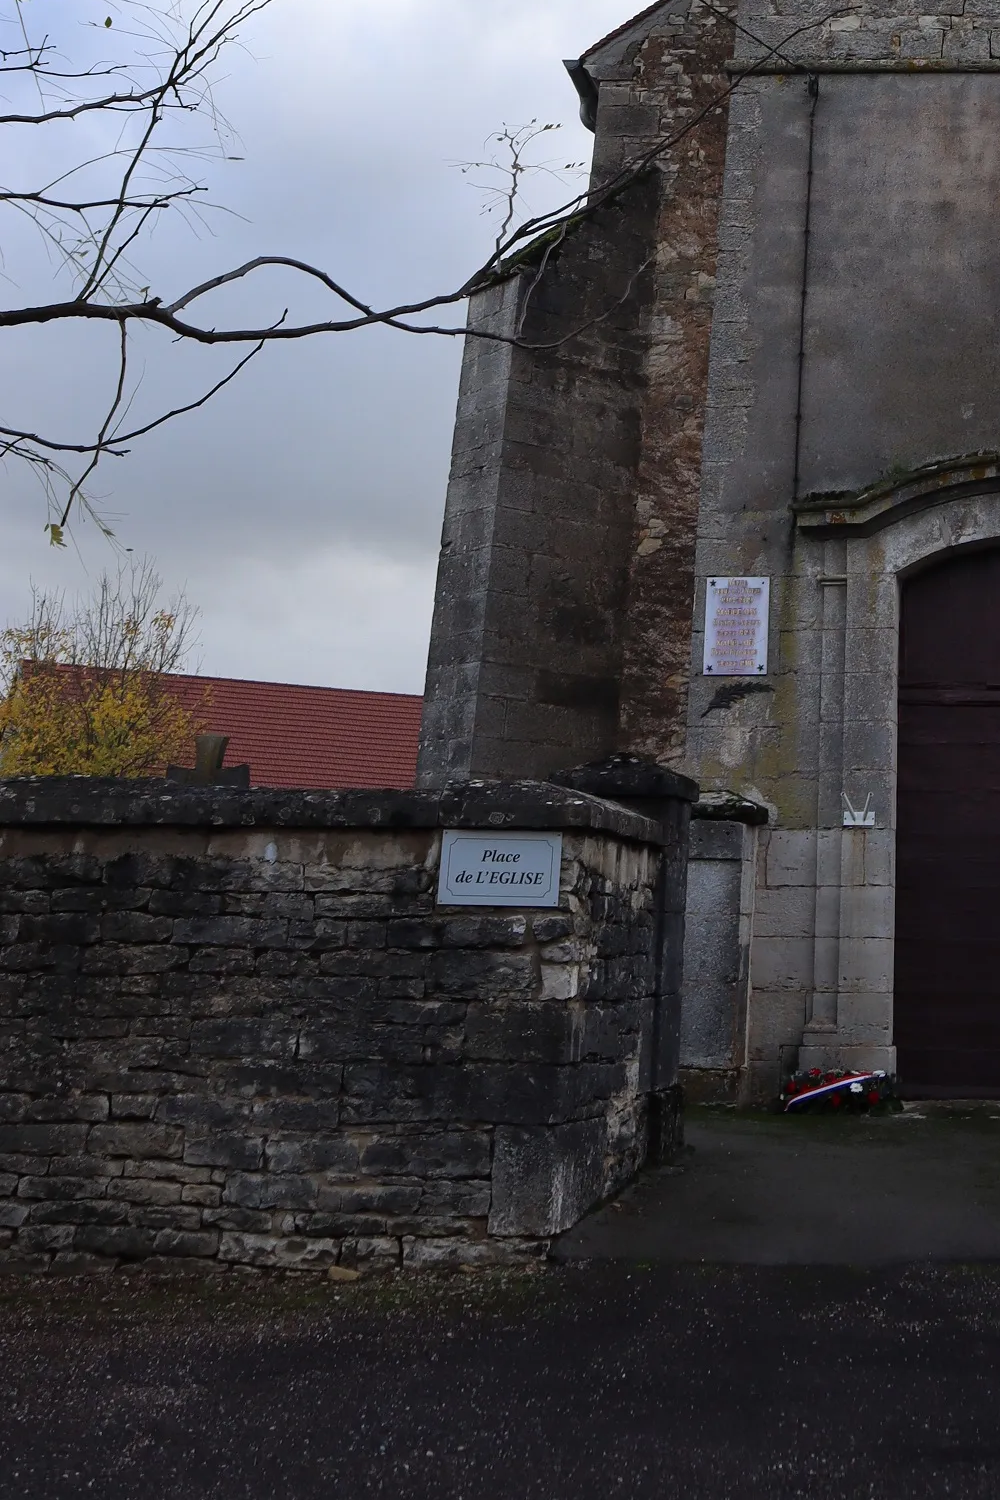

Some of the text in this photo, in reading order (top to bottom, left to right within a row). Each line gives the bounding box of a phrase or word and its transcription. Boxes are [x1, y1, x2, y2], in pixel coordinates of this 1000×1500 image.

[481, 850, 521, 863] Place
[455, 870, 544, 885] de L’EGLISE
